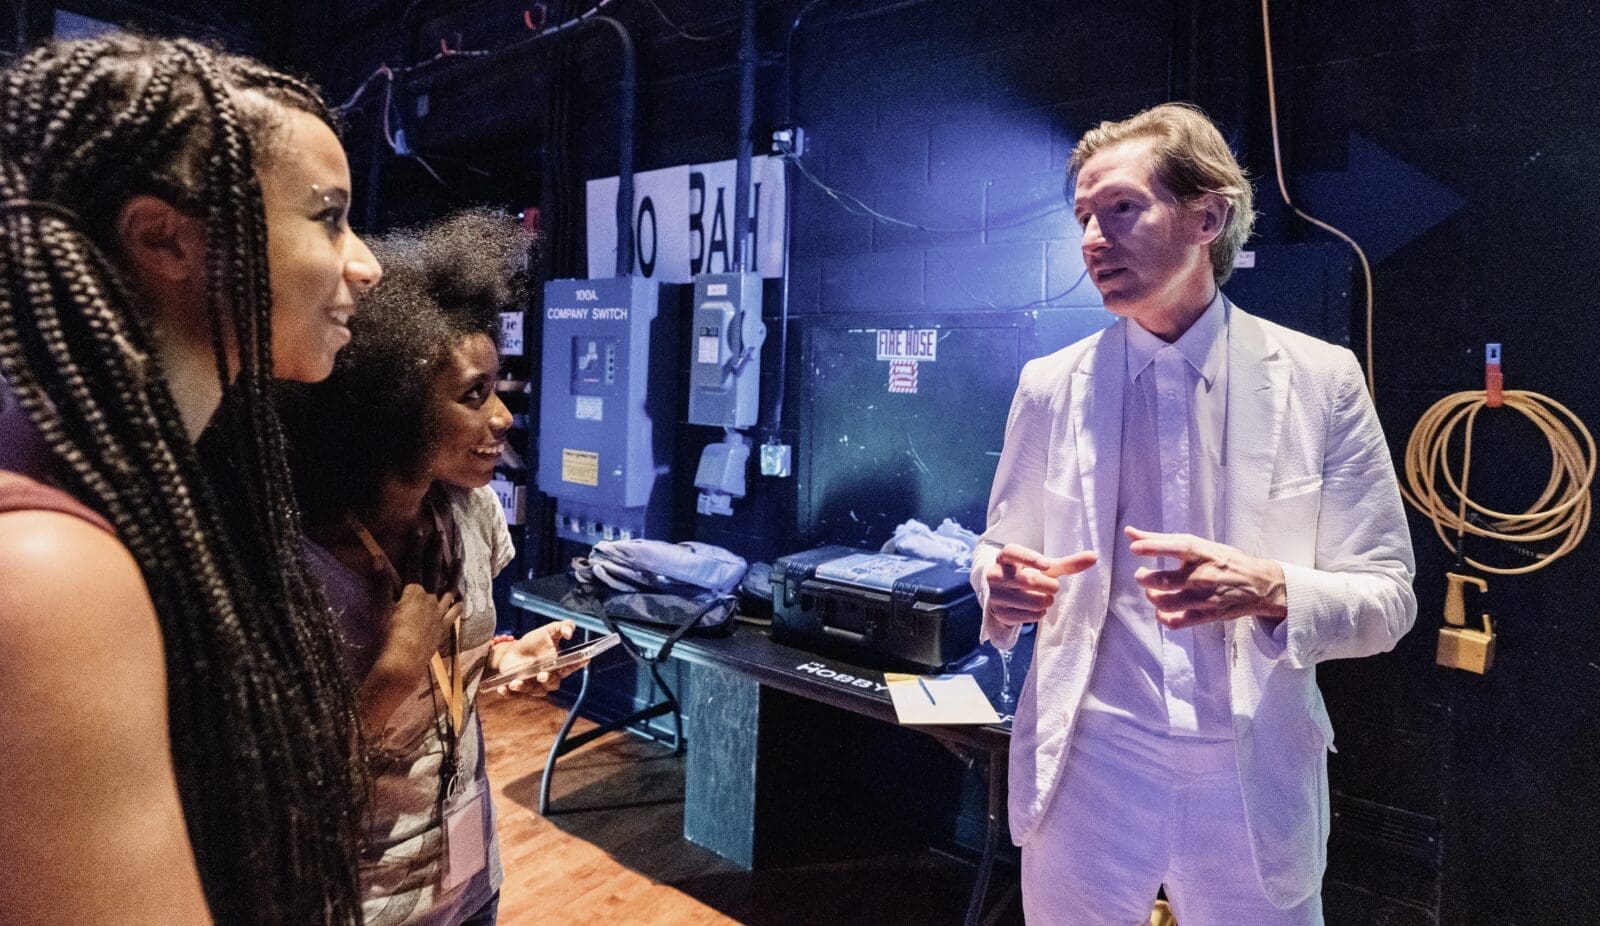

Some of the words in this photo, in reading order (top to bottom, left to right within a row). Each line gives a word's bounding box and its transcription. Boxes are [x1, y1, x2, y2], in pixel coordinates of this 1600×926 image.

[547, 308, 589, 320] COMPANY
[592, 308, 628, 321] SWITCH
[879, 330, 902, 356] FIRE
[905, 331, 934, 357] HOSE
[796, 663, 889, 692] HOBBY
